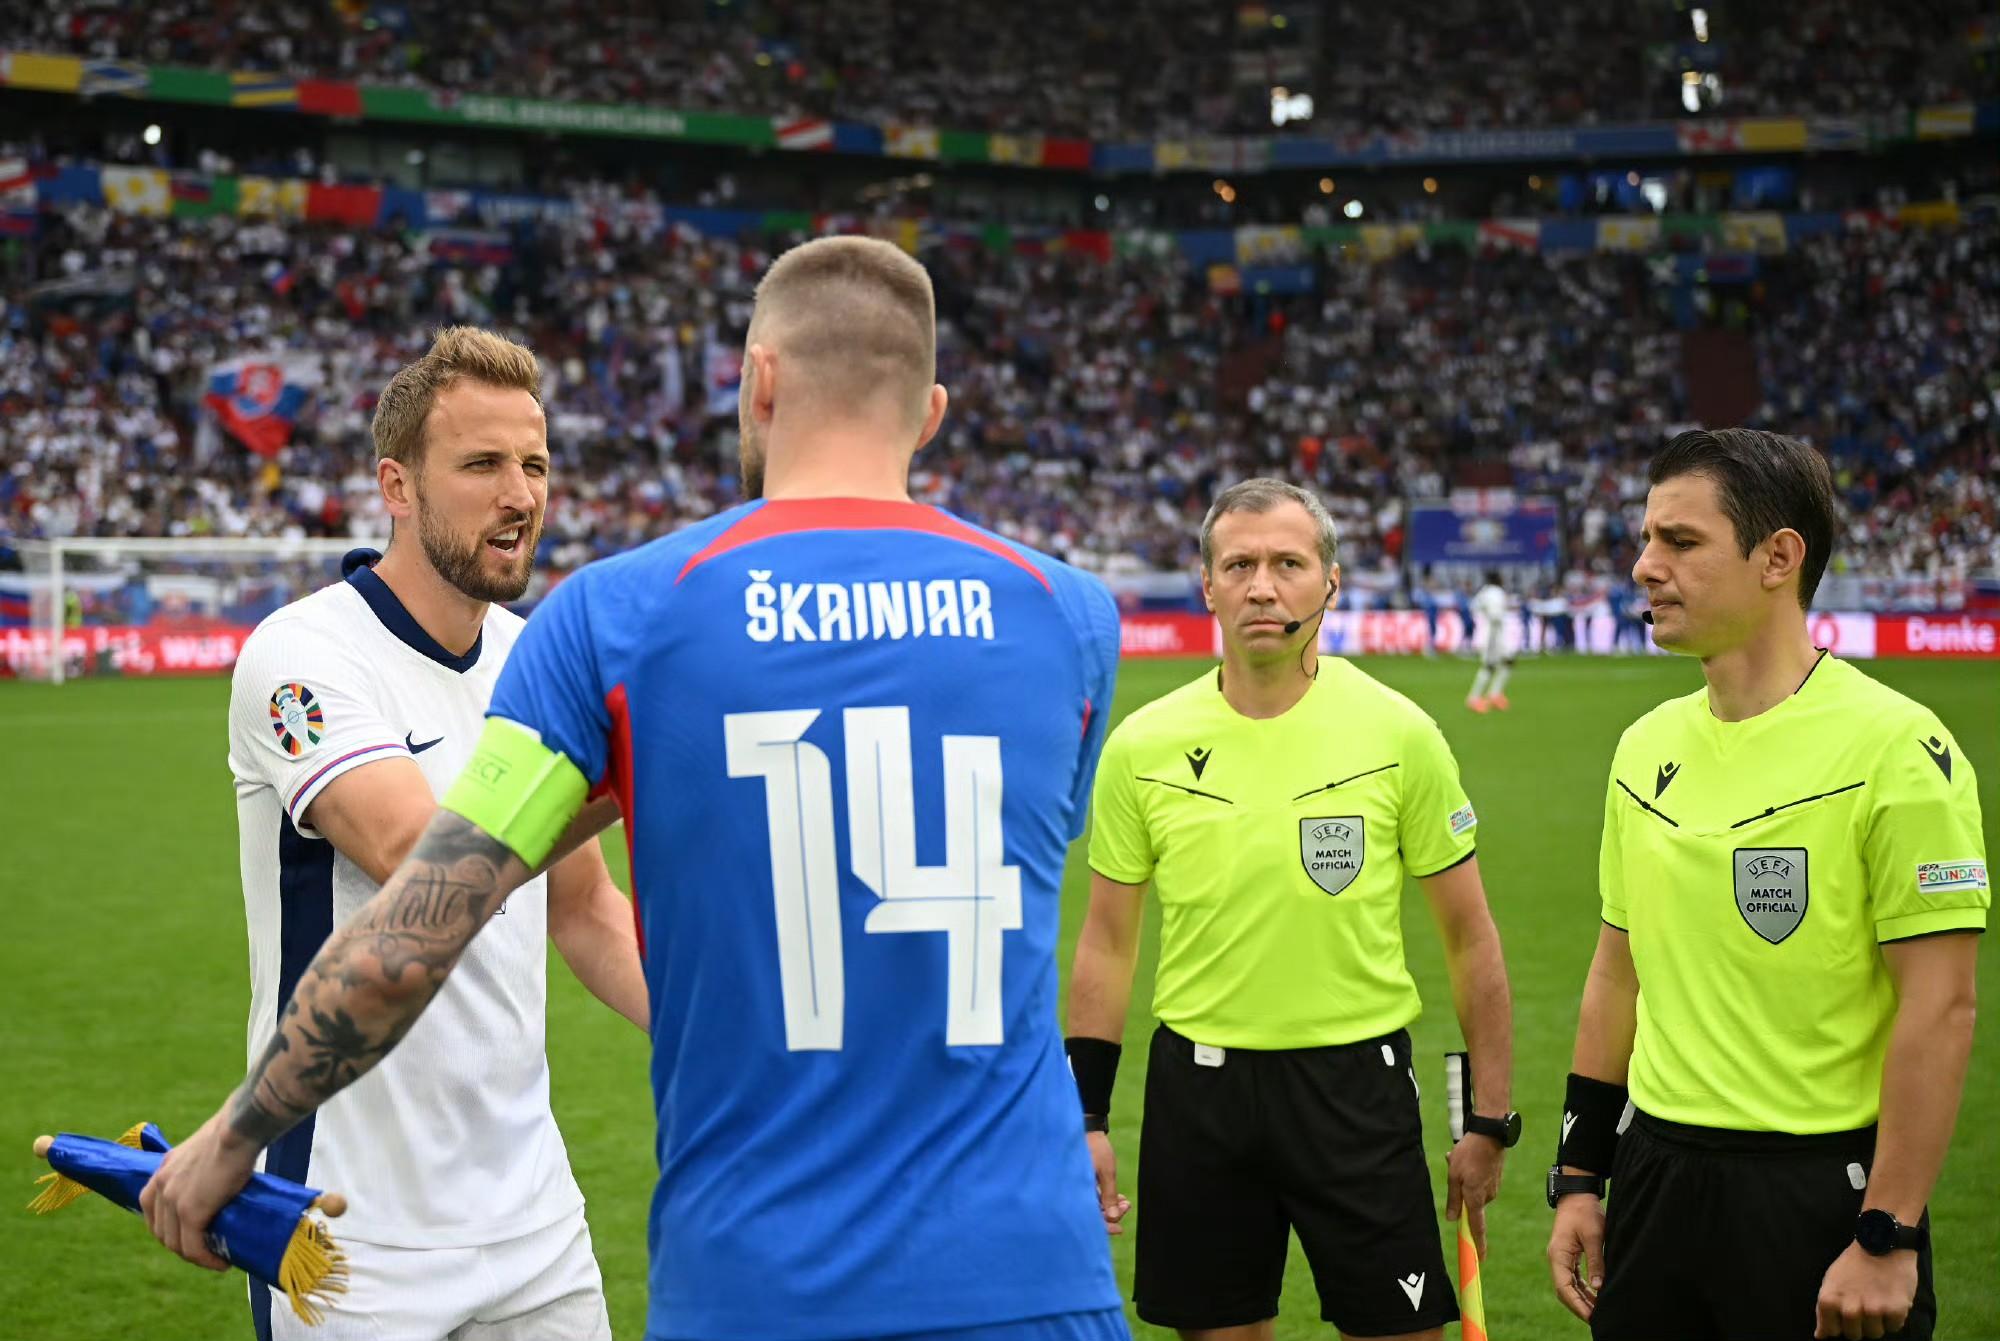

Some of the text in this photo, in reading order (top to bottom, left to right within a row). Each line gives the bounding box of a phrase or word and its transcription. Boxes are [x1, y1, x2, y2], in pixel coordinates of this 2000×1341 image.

[745, 569, 995, 642] ŠKRINIAR
[1906, 616, 1996, 652] Danke
[1314, 826, 1350, 840] UEFA
[1316, 849, 1352, 858] MATCH
[1311, 861, 1356, 870] OFFICIAL
[1748, 860, 1790, 877] UEFA
[724, 705, 1024, 1051] 14
[1751, 889, 1792, 898] MATCH
[1746, 903, 1798, 913] OFFICIAL
